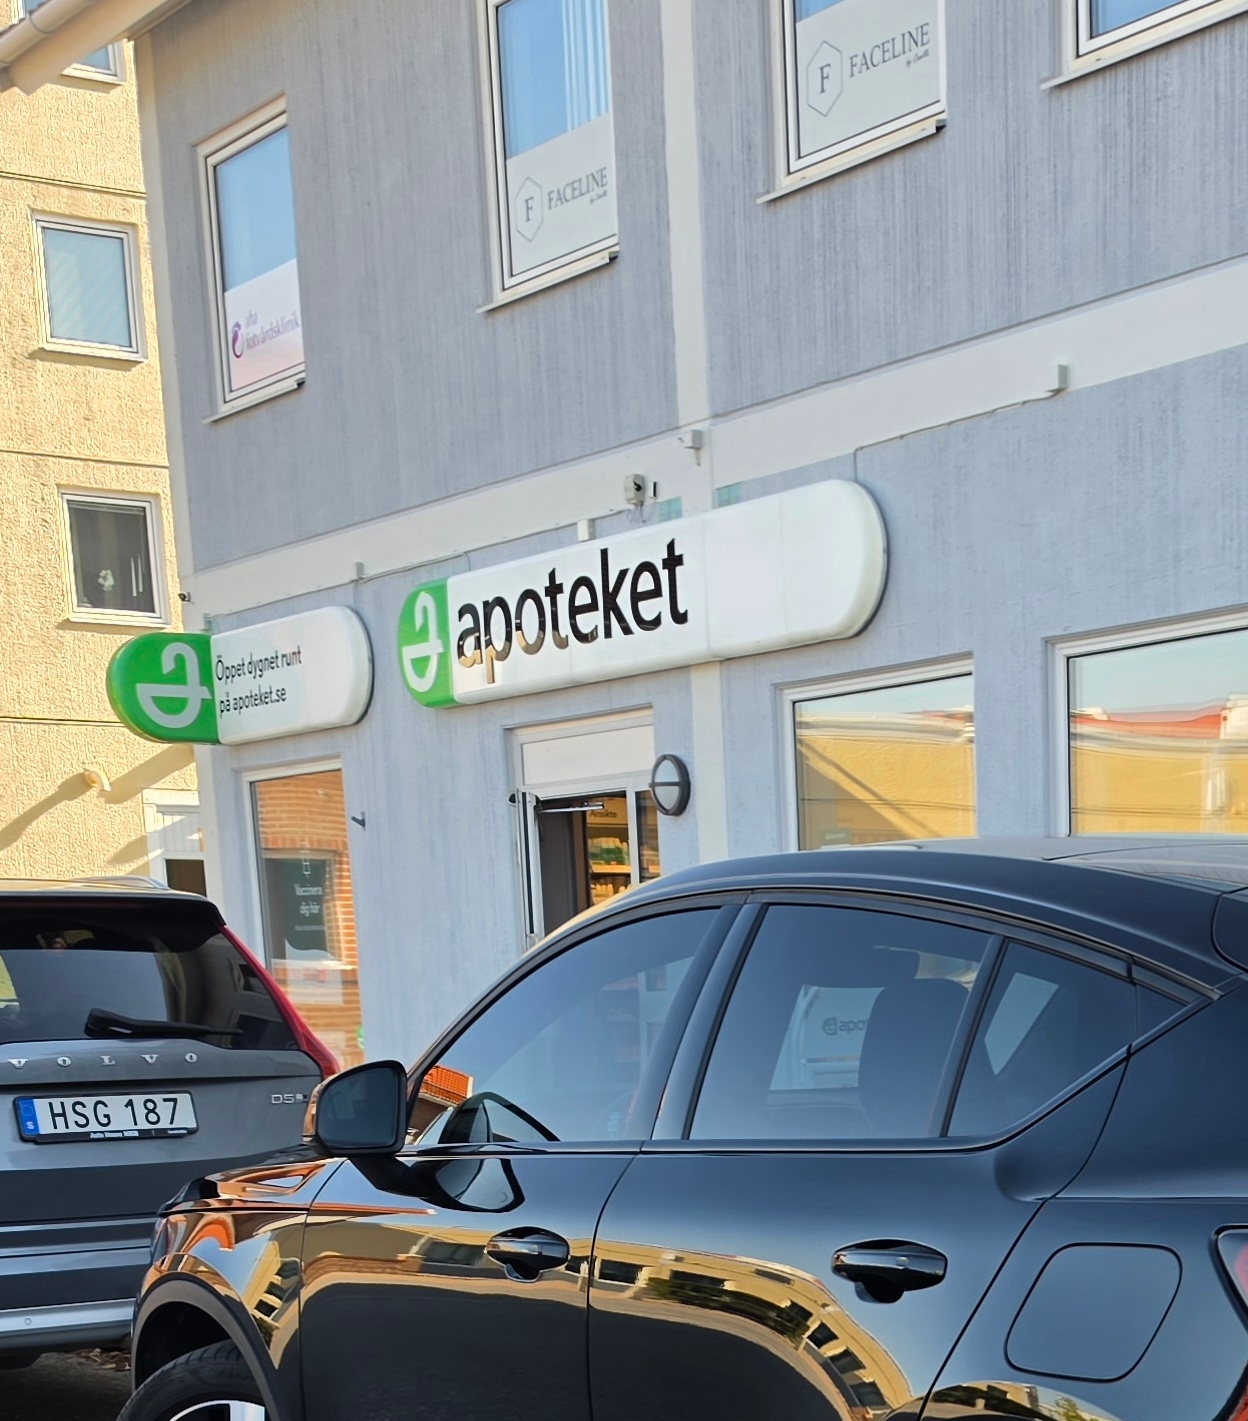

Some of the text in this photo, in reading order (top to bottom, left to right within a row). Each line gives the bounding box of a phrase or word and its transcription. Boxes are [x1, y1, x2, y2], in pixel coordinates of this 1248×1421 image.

[849, 22, 930, 78] FACELINE
[547, 167, 608, 211] FACELINE
[458, 538, 689, 684] apoteket
[215, 645, 302, 685] Öppet dygnet runt
[220, 684, 287, 719] på apoteket.se
[7, 1053, 198, 1069] VOLVO
[48, 1097, 178, 1130] HSG 187
